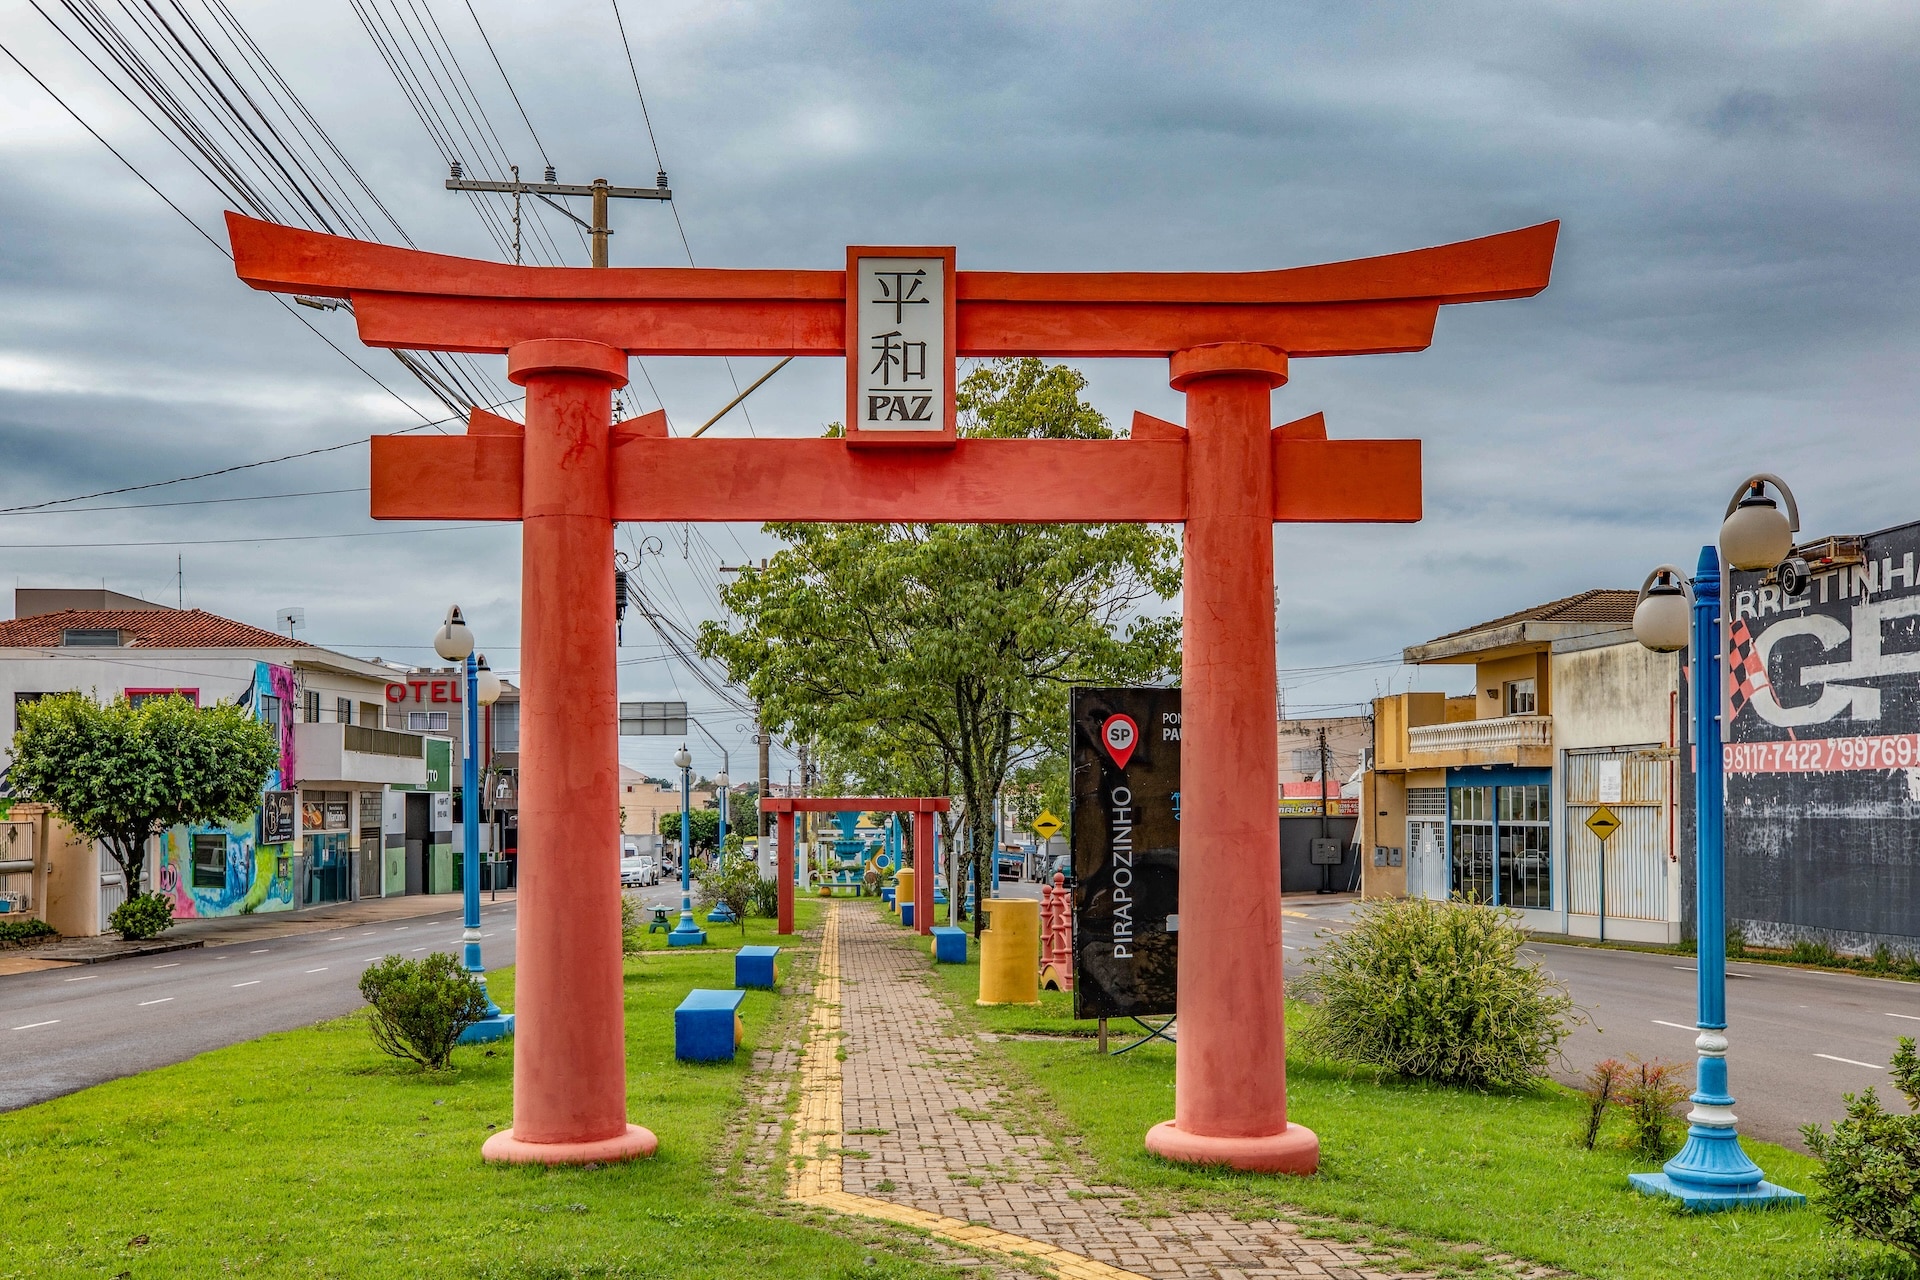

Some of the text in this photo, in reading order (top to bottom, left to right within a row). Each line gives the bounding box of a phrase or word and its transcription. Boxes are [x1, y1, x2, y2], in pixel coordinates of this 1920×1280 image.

[871, 268, 930, 386] 平和
[867, 395, 934, 422] PAZ
[1729, 551, 1920, 622] RRETINH
[1110, 728, 1131, 742] SP
[1162, 727, 1182, 741] PA
[1841, 734, 1920, 768] 99769-
[1111, 786, 1134, 959] PIRAPOZINHO
